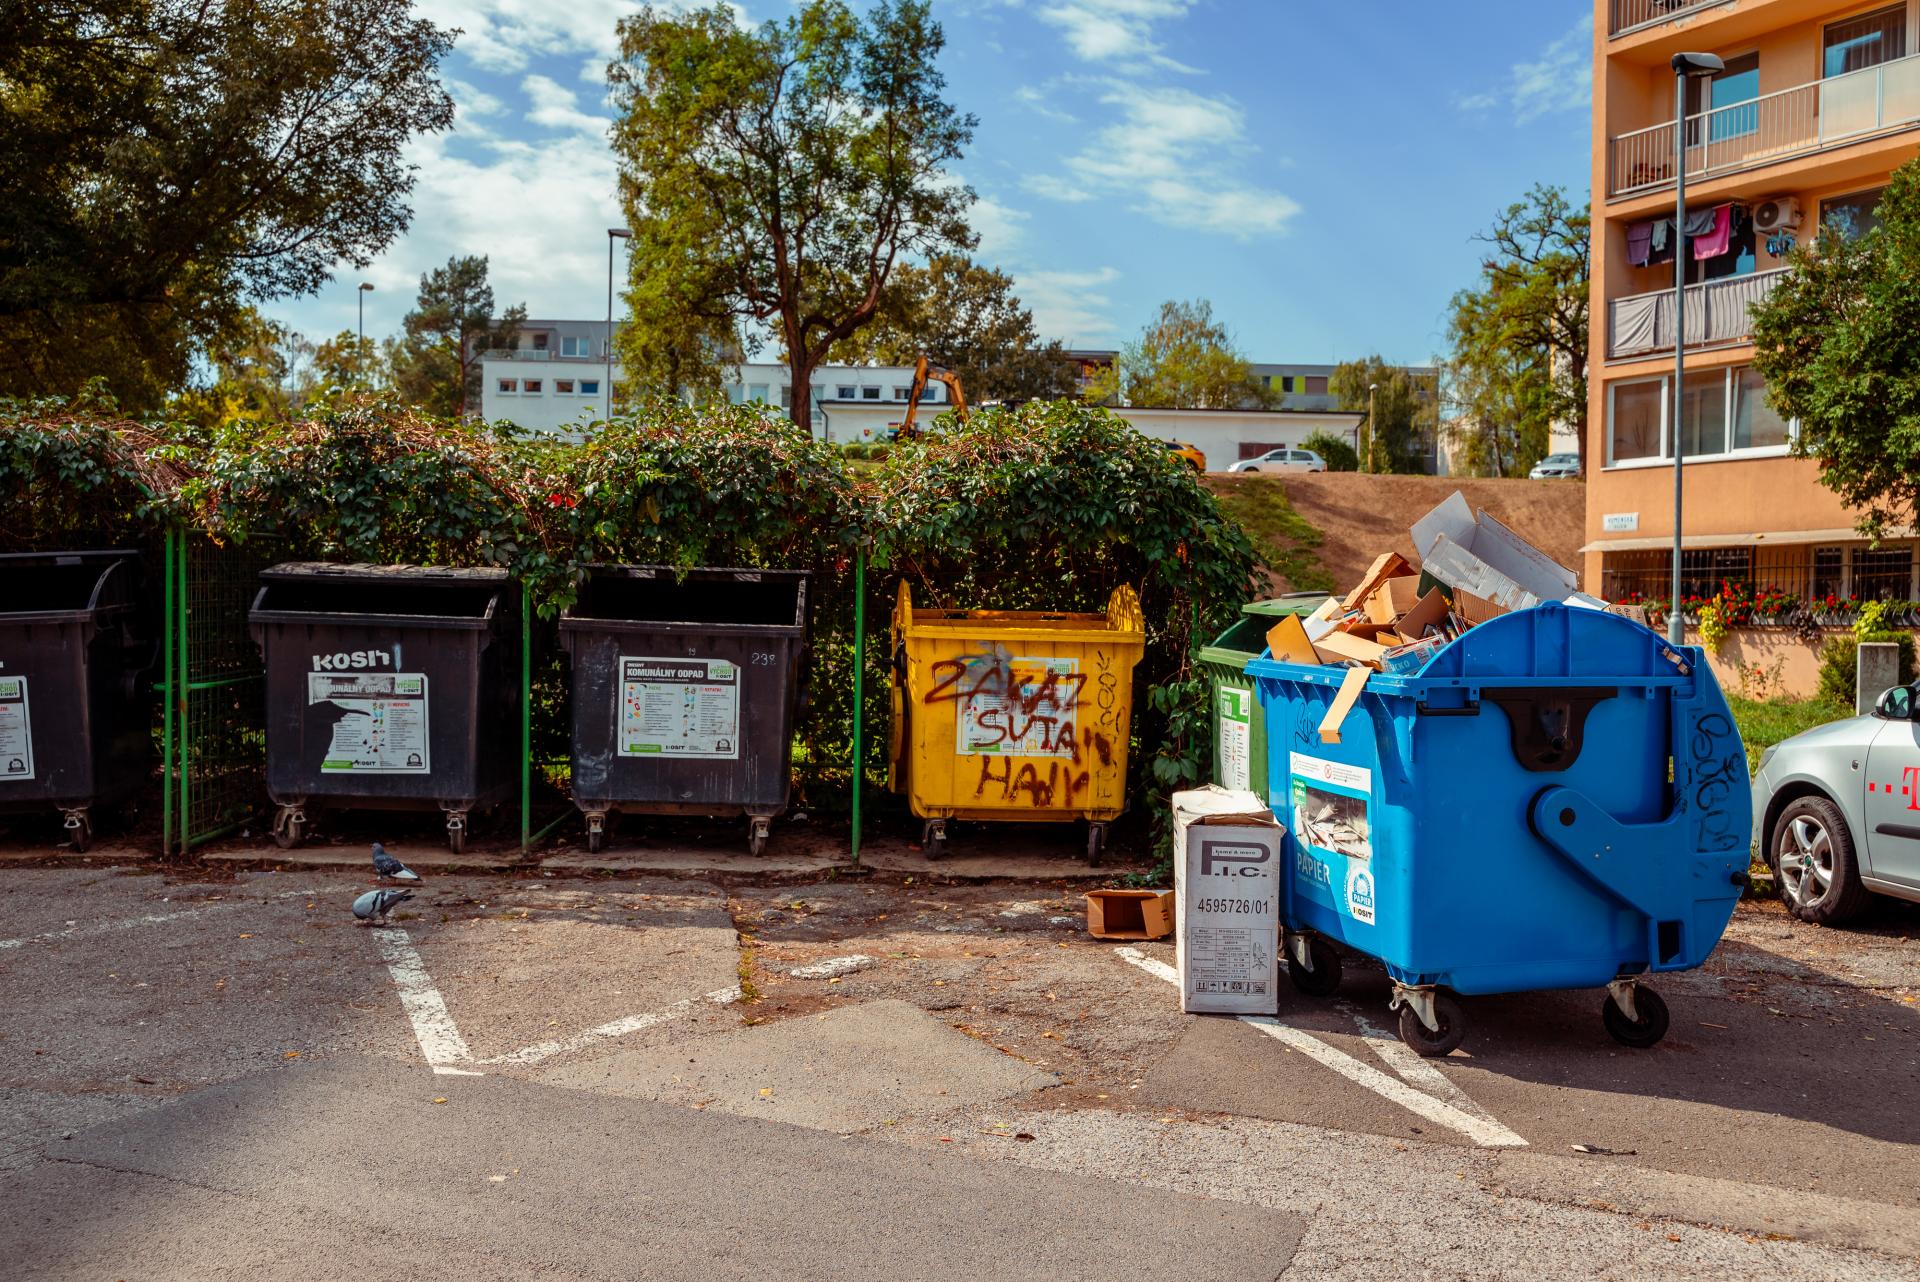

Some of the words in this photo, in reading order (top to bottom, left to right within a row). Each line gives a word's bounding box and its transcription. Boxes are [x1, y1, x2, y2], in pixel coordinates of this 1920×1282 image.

[626, 667, 676, 677] KOMUNÁLNY
[677, 670, 704, 678] ODPAD
[1297, 853, 1330, 885] PAPIER
[1197, 898, 1268, 914] 4595726/01
[1353, 893, 1372, 907] PAPIER
